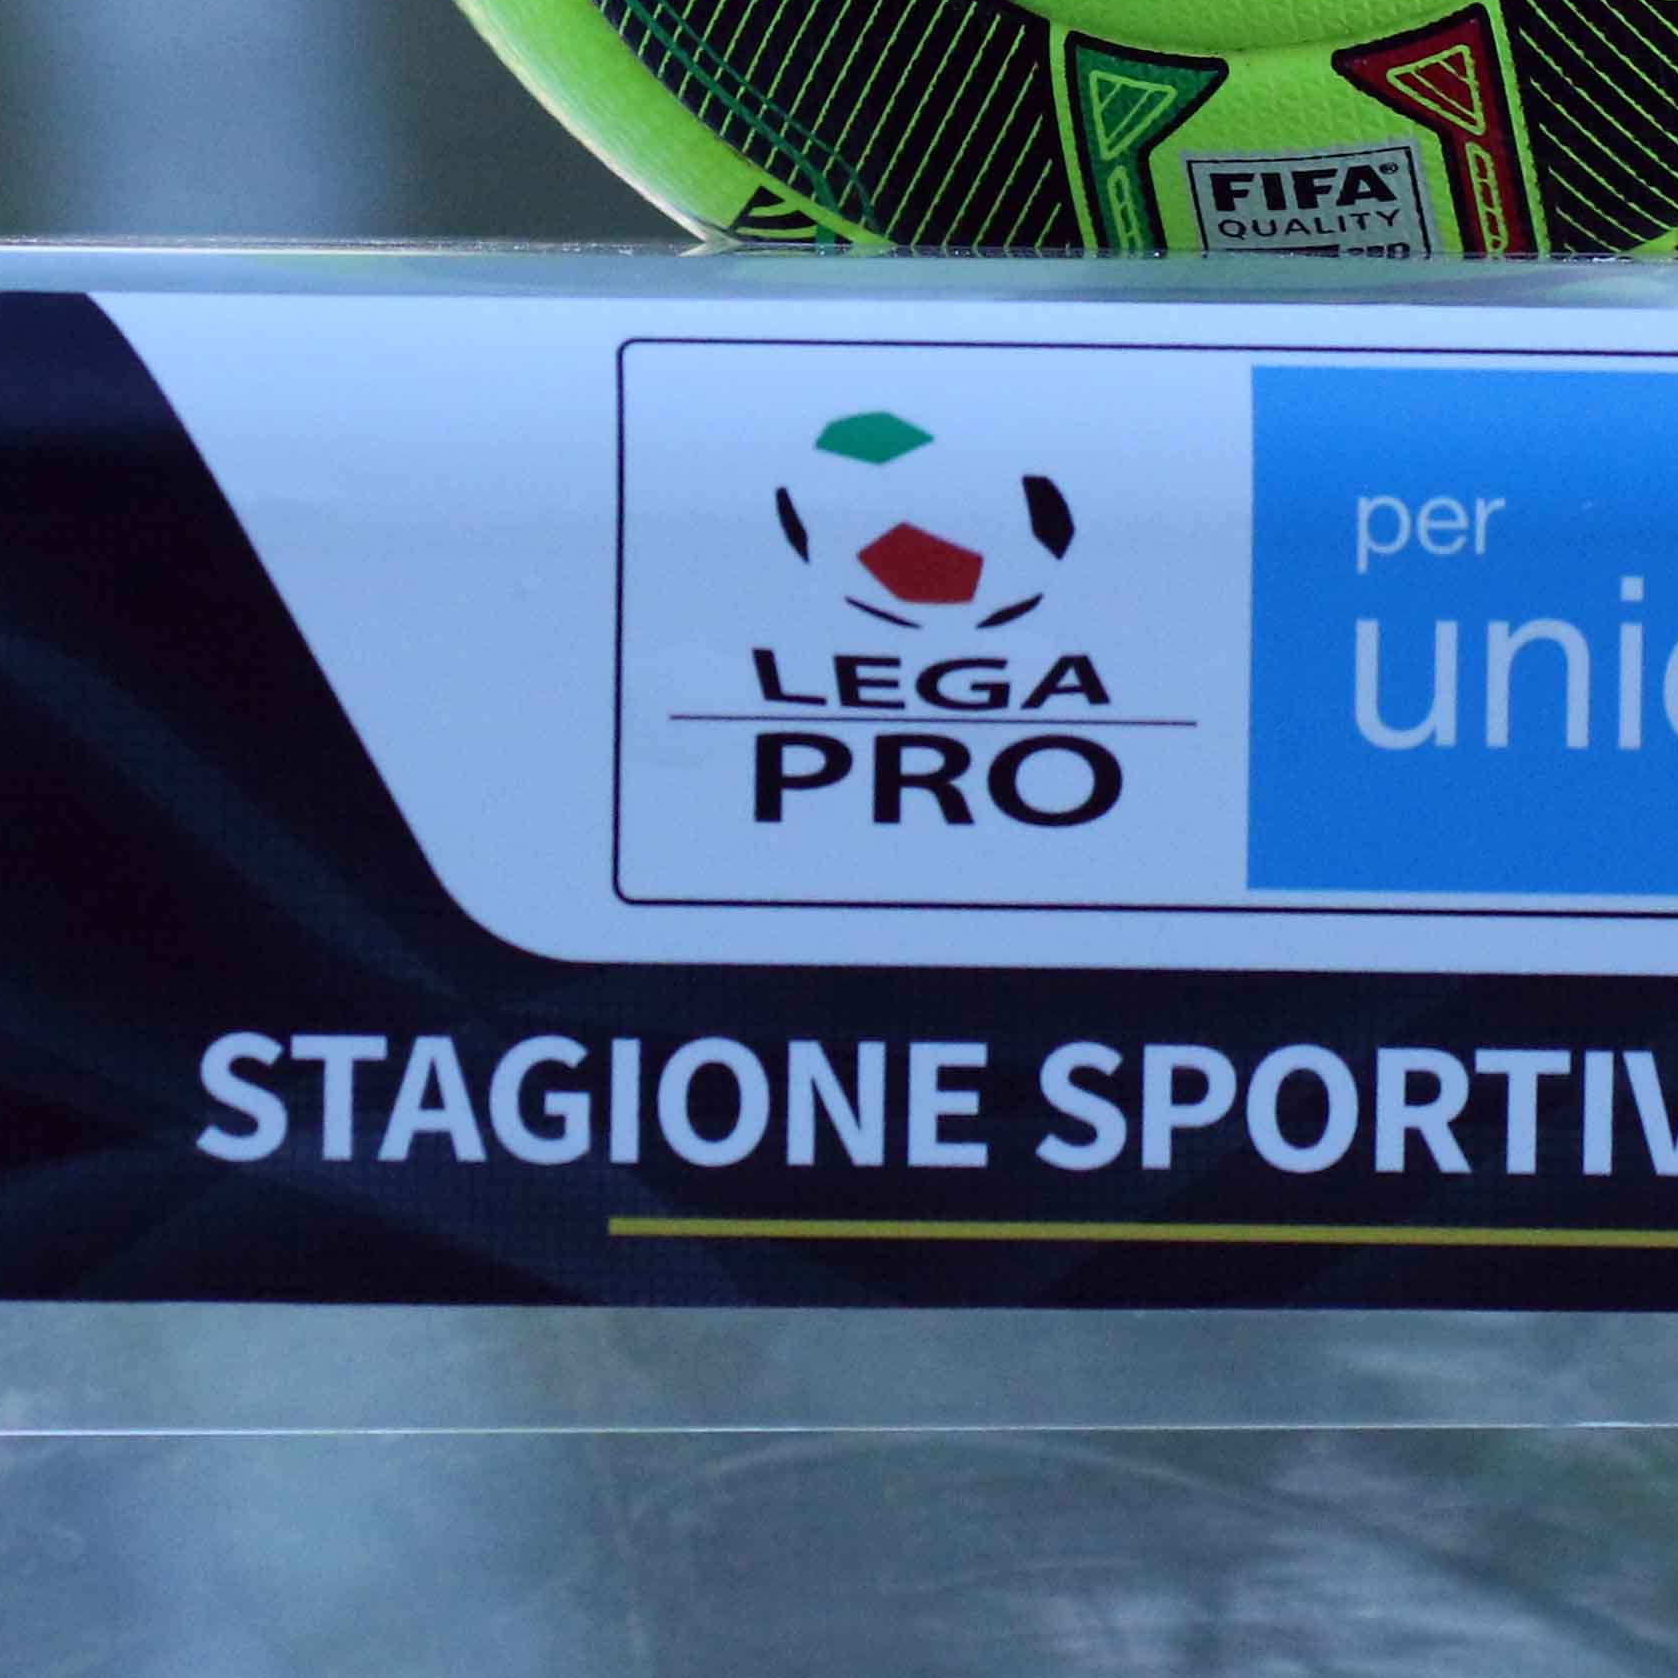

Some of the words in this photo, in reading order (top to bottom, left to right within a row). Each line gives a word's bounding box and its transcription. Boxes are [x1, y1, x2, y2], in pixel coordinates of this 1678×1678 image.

[1217, 208, 1402, 240] QUALITY
[1356, 495, 1507, 574] per
[751, 648, 1113, 712] LEGA
[752, 731, 1124, 829] PRO
[197, 1033, 989, 1168] STAGIONE
